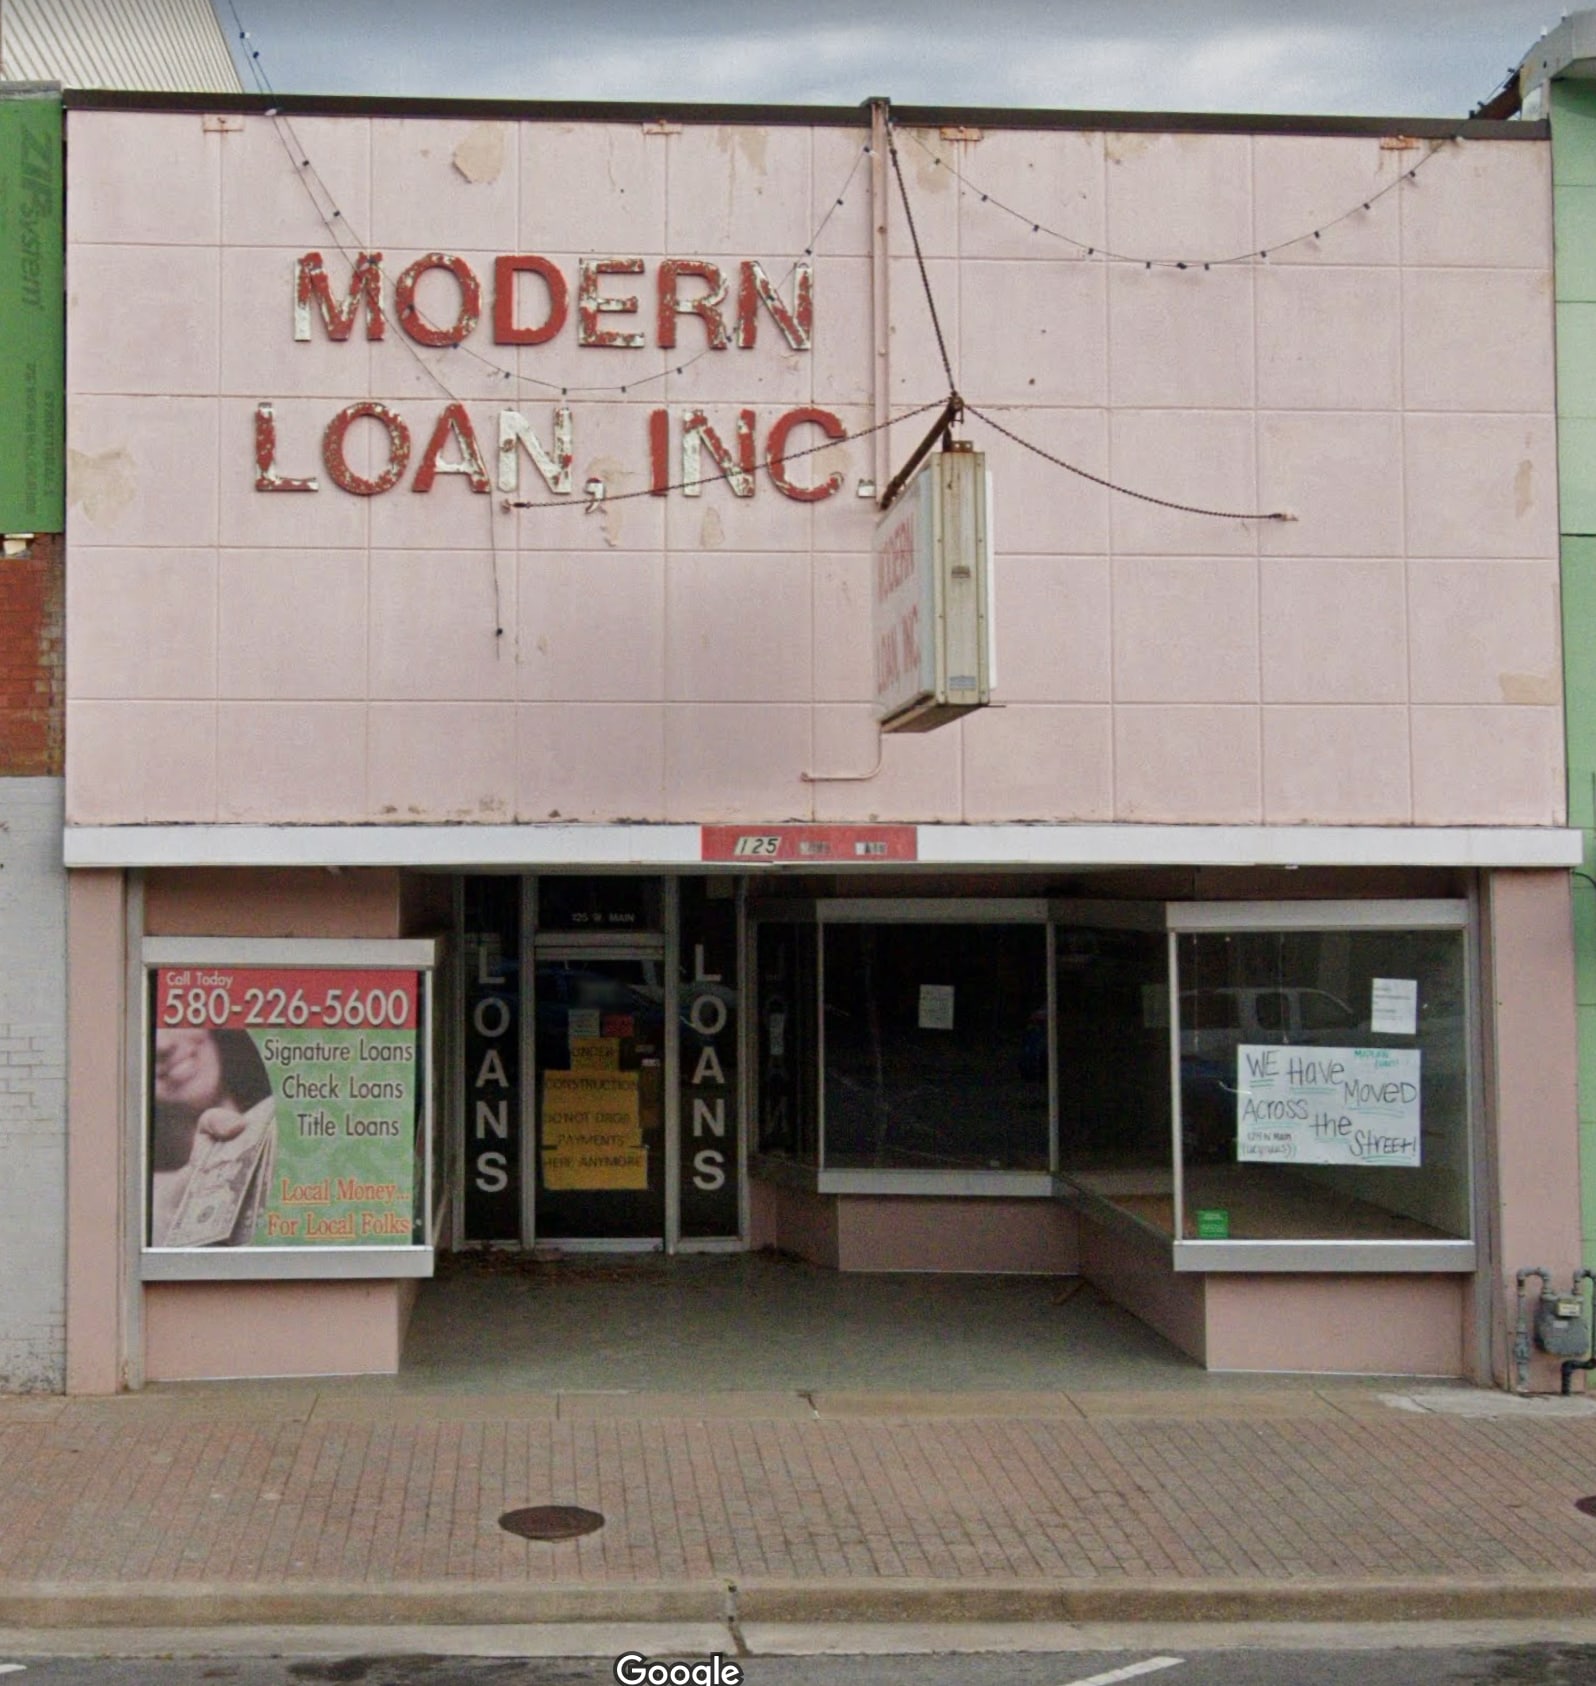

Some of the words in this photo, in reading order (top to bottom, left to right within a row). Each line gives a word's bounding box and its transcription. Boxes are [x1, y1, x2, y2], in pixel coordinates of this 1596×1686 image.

[293, 251, 813, 351] MODERN
[255, 402, 607, 514] LOAN,
[649, 406, 876, 501] INC.
[739, 837, 779, 854] 125
[608, 911, 636, 923] MAIN
[166, 971, 191, 986] Call
[196, 971, 234, 989] Today
[162, 987, 410, 1027] 580-226-5600
[263, 1039, 351, 1066] Signature
[359, 1039, 414, 1063] Loans
[474, 945, 511, 1193] LOANS
[690, 943, 728, 1191] LOANS
[1246, 1050, 1280, 1078] WE
[1286, 1057, 1345, 1087] Have
[282, 1073, 340, 1099] Check
[349, 1074, 404, 1099] Loans
[297, 1111, 337, 1137] Title
[345, 1114, 400, 1138] Loans
[1309, 1112, 1353, 1137] the
[281, 1177, 331, 1204] Local
[336, 1178, 411, 1206] Money...
[267, 1212, 299, 1237] For
[304, 1212, 356, 1238] Local
